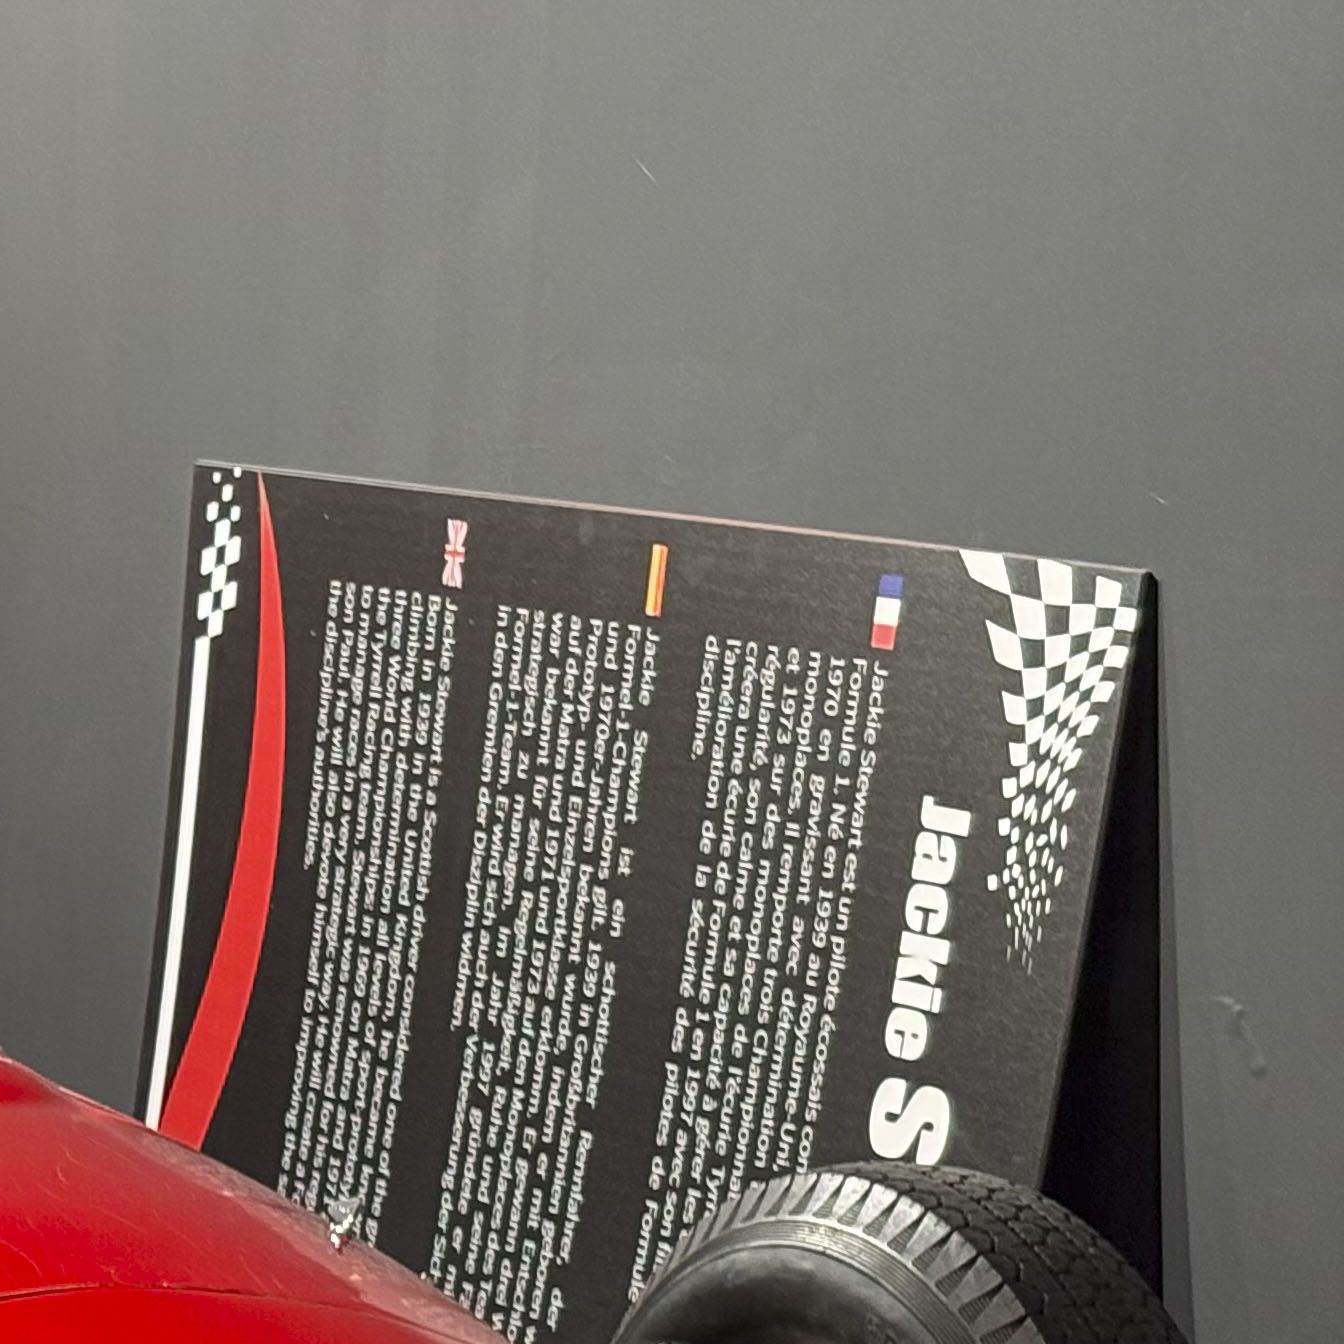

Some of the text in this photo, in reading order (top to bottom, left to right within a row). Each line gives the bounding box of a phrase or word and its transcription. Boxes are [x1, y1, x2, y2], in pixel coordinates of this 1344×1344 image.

[423, 594, 442, 651] Born
[439, 597, 460, 672] Jackie
[496, 604, 513, 628] in
[547, 611, 564, 658] war
[566, 614, 586, 655] auf
[420, 658, 436, 682] in
[491, 631, 510, 678] den
[517, 608, 549, 737] strategisch
[603, 620, 623, 670] und
[637, 625, 662, 706] Jackie
[561, 656, 581, 700] der
[573, 617, 604, 732] Prototyp-
[686, 634, 723, 761] discipline.
[737, 640, 764, 720] créera
[414, 692, 433, 746] 1939
[430, 674, 452, 763] Stewart
[535, 666, 561, 766] bekannt
[746, 644, 784, 772] régularité,
[837, 657, 870, 767] Formule
[862, 660, 891, 745] Jackie
[480, 681, 505, 783] Gremien
[553, 702, 576, 770] Matra
[593, 622, 642, 881] Formel-1-Champions
[729, 725, 748, 775] une
[783, 650, 826, 816] monoplaces.
[411, 752, 427, 775] in
[427, 767, 443, 788] is
[516, 750, 530, 779] zu
[570, 738, 591, 788] und
[581, 682, 617, 853] 1970er-Jahren
[623, 729, 650, 824] Stewart
[833, 774, 853, 796] 1.
[406, 782, 424, 822] the
[425, 789, 438, 805] a
[475, 786, 493, 828] der
[493, 794, 510, 822] Er
[530, 774, 549, 810] für
[547, 773, 568, 822] und
[718, 777, 744, 858] écurie
[743, 777, 762, 825] son
[847, 749, 878, 849] Stewart
[487, 822, 507, 876] wird
[784, 821, 802, 837] Il
[826, 802, 849, 841] Né
[397, 828, 419, 906] United
[415, 810, 439, 901] Scottish
[522, 817, 544, 882] seine
[540, 828, 562, 881] 1971
[617, 846, 636, 877] ist
[731, 830, 758, 911] calme
[821, 844, 839, 879] en
[841, 852, 863, 892] est
[460, 830, 488, 928] Disziplin
[480, 878, 500, 926] sich
[540, 794, 584, 1001] Einzelsportklasse
[712, 860, 733, 895] de
[713, 646, 806, 1156] et 1973 sur des monoplaces de l'écurie
[762, 842, 799, 963] remporte
[533, 885, 555, 934] und
[567, 863, 595, 964] bekannt
[608, 898, 629, 938] ein
[726, 915, 746, 942] et
[752, 655, 847, 1168] 1970 en gravissant avec détermination
[810, 887, 836, 948] 1939
[835, 896, 853, 931] un
[885, 795, 972, 1061] Jackie
[406, 904, 428, 972] driver
[473, 928, 494, 988] auch
[494, 925, 512, 958] Im
[697, 899, 728, 1005] Formule
[721, 947, 738, 976] sa
[525, 939, 548, 994] 1973
[581, 940, 604, 998] 1939
[626, 638, 744, 1303] l'amélioration de la sécurité des pilotes de Formule
[804, 952, 823, 987] au
[818, 935, 851, 1011] pilote
[467, 990, 486, 1031] der
[485, 971, 506, 1026] Jahr
[519, 996, 540, 1036] auf
[576, 1003, 595, 1028] in
[695, 1009, 712, 1022] 1
[756, 967, 780, 1025] trois
[377, 1029, 395, 1061] he
[388, 973, 420, 1101] considered
[512, 1037, 534, 1085] den
[583, 960, 620, 1109] schottischer
[689, 1027, 706, 1061] en
[700, 981, 736, 1090] capacité
[475, 1041, 497, 1096] 1997
[768, 993, 820, 1172] Royaume-Uni,
[802, 1013, 838, 1122] écossais
[362, 1066, 390, 1158] became
[440, 1033, 480, 1190] Verbesserung
[485, 1085, 509, 1148] Ruhe
[540, 1065, 567, 1143] indem
[546, 1033, 591, 1214] Großbritannien
[678, 1067, 703, 1127] 1997
[700, 1094, 719, 1112] à
[380, 1102, 398, 1148] one
[520, 1126, 539, 1154] Er
[684, 1116, 715, 1183] gérer
[376, 1150, 393, 1176] of
[453, 1106, 487, 1215] gründete
[476, 1155, 498, 1204] und
[486, 1087, 527, 1230] Monoplaces
[534, 1152, 550, 1180] er
[668, 1128, 690, 1187] avec
[369, 1178, 389, 1217] the
[437, 1192, 456, 1232] der
[500, 1157, 530, 1252] gewann
[525, 1188, 547, 1229] mit
[658, 1190, 679, 1237] son
[680, 1187, 702, 1224] les
[450, 1226, 465, 1253] er
[464, 1211, 489, 1274] seine
[481, 1231, 503, 1275] des
[493, 1258, 516, 1306] drei
[524, 1219, 560, 1319] geboren
[543, 1287, 566, 1331] der
